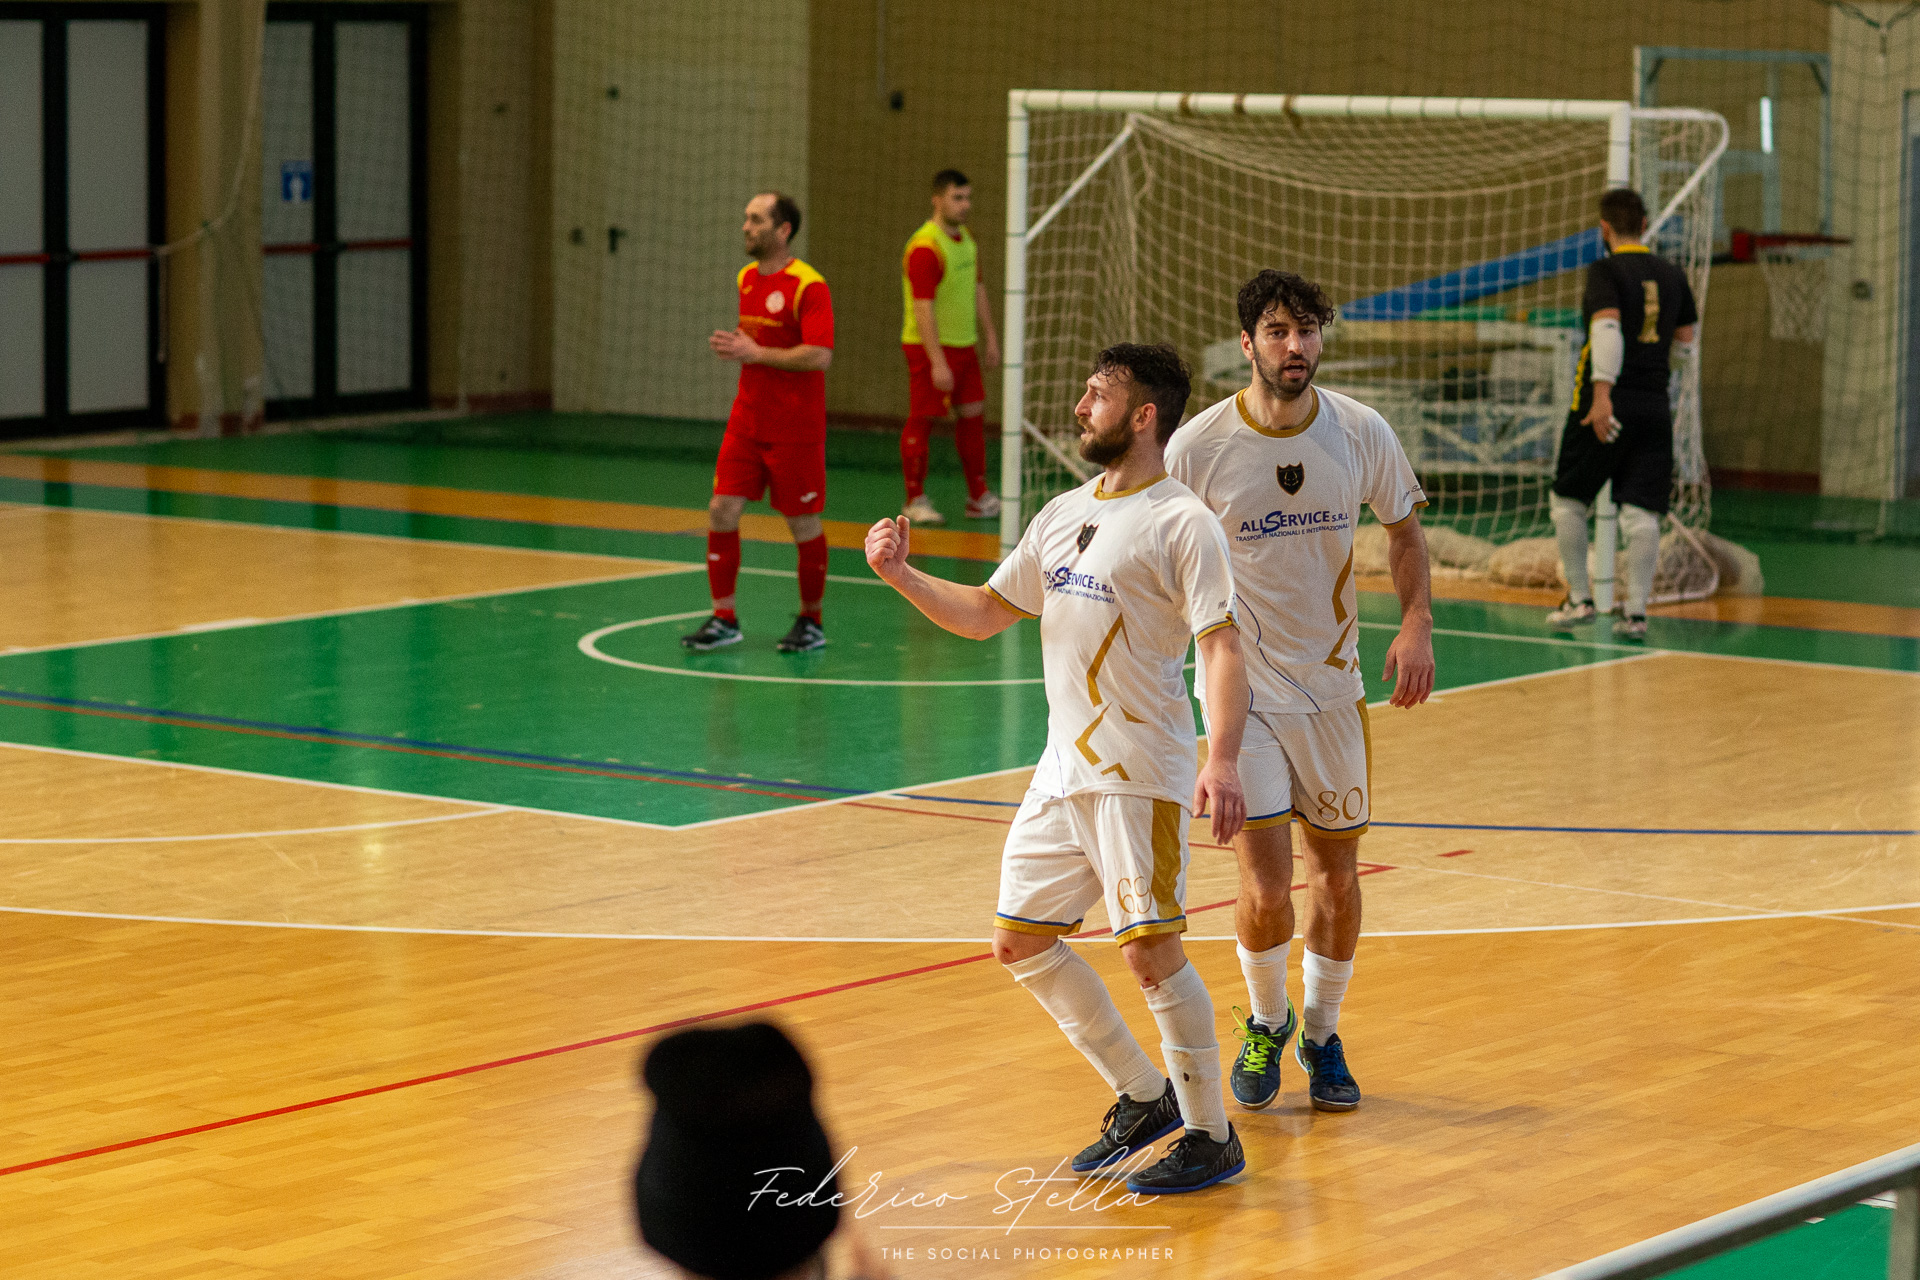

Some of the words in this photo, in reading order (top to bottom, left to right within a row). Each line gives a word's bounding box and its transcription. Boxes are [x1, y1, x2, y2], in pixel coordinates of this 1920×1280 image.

[1637, 280, 1660, 343] 1
[1235, 533, 1267, 542] TRASPORTI
[1269, 529, 1300, 538] NAZIONALI
[1306, 522, 1350, 534] INTERNAZIONALI
[1240, 511, 1331, 534] ALLSERVICE
[1317, 786, 1364, 822] 80
[1117, 875, 1152, 915] 69
